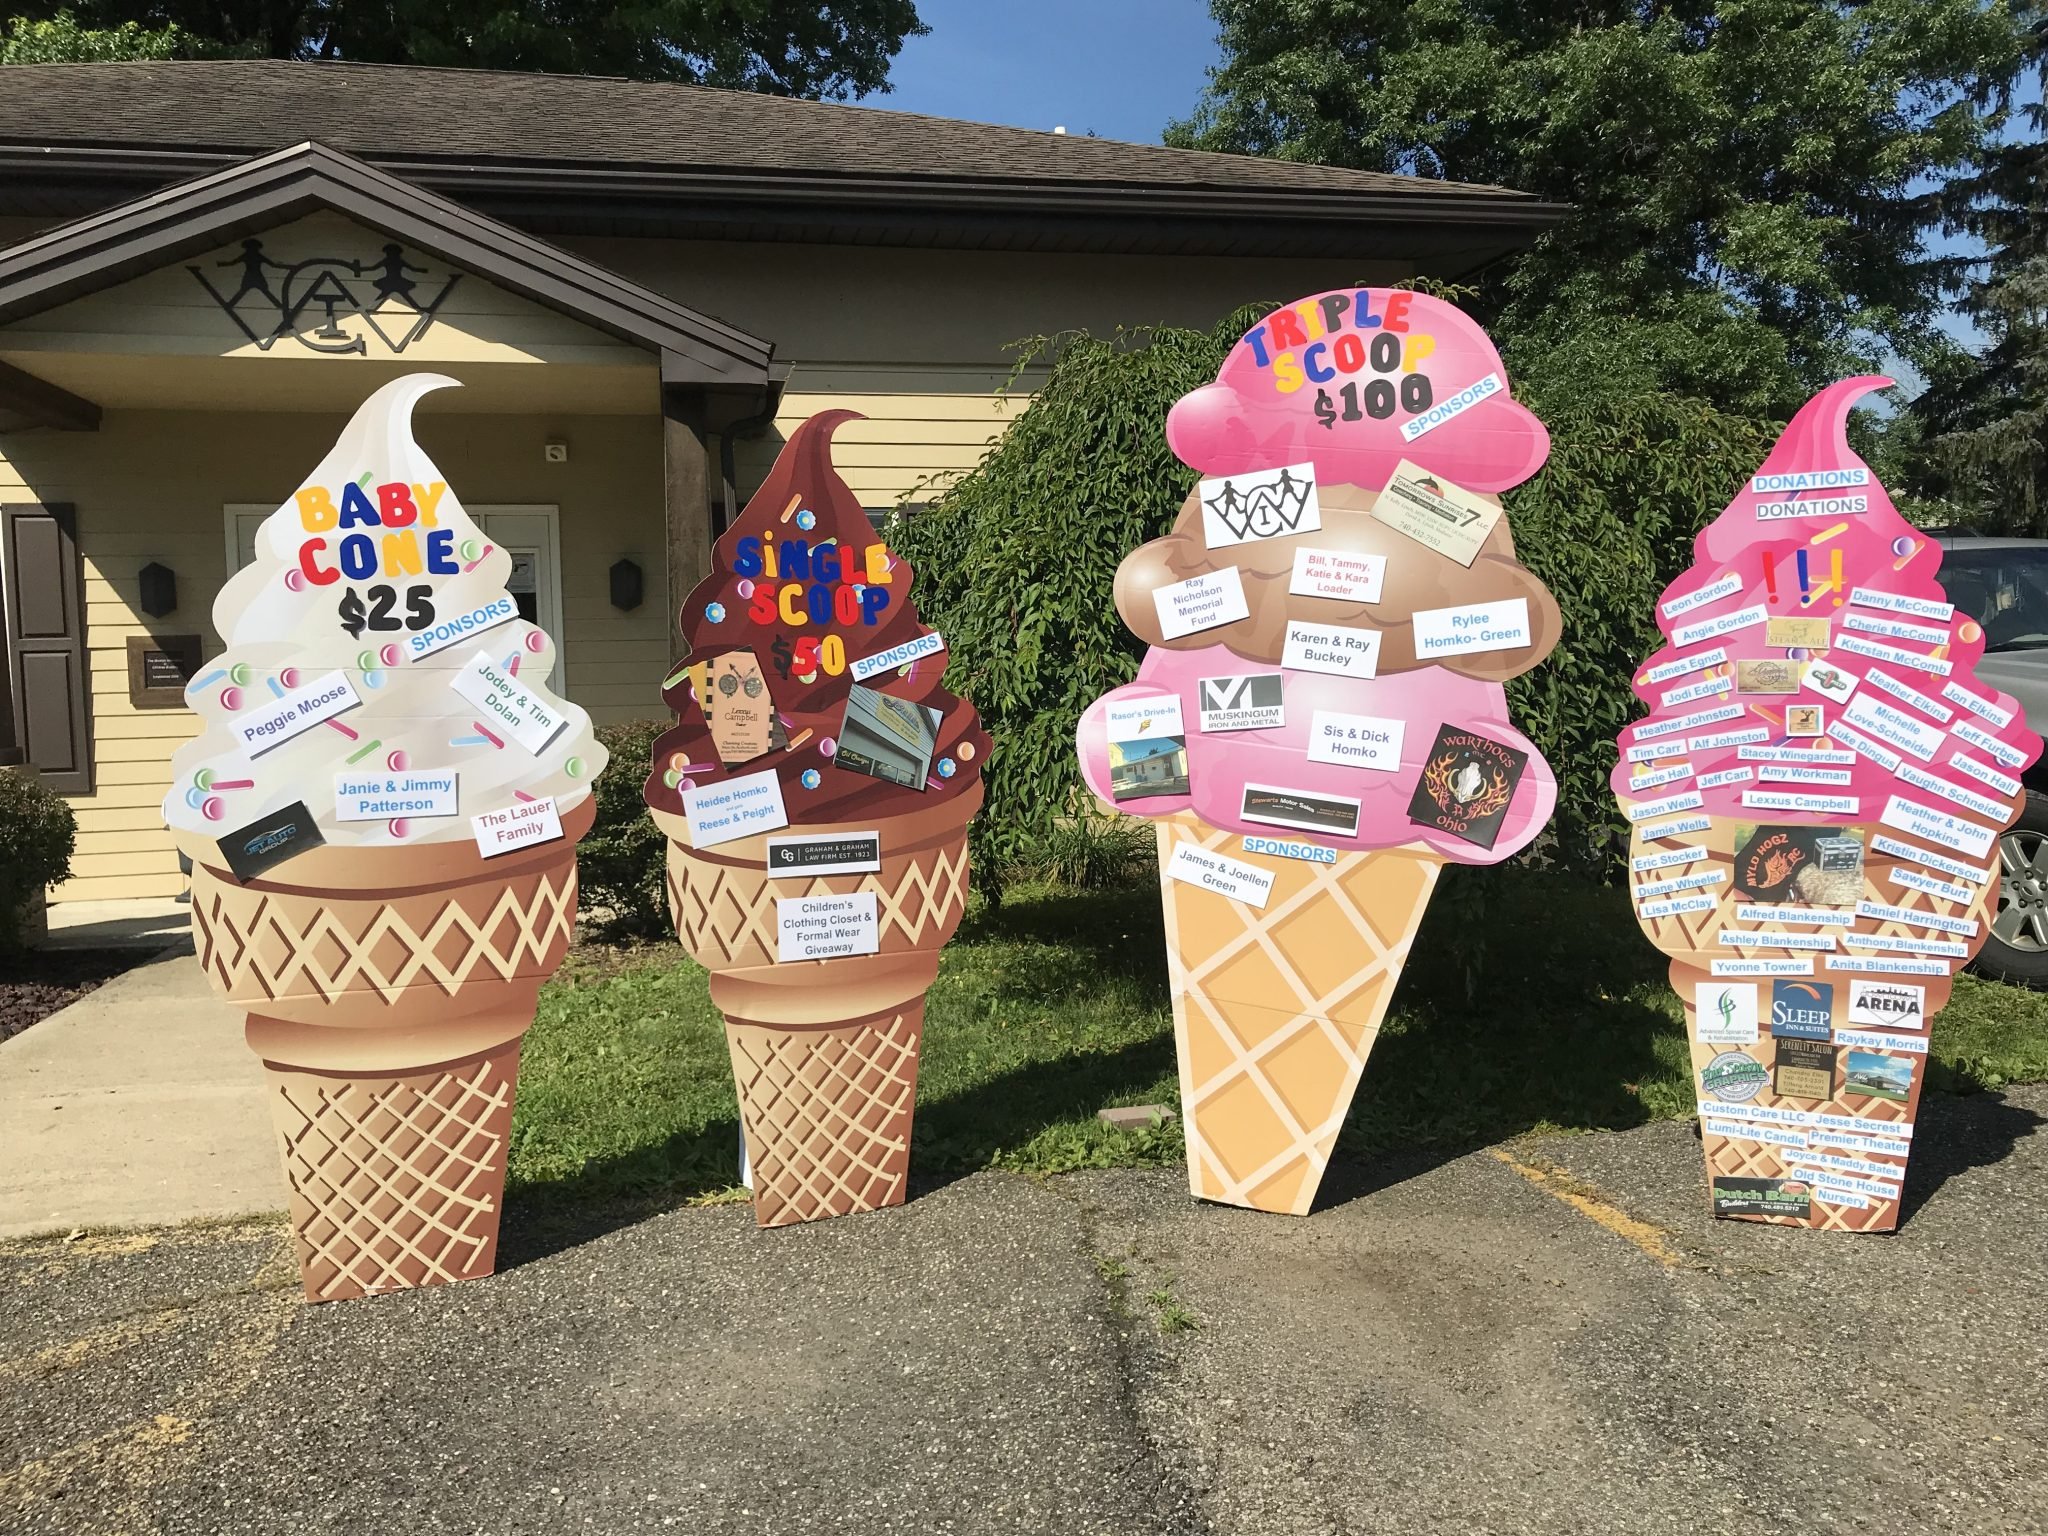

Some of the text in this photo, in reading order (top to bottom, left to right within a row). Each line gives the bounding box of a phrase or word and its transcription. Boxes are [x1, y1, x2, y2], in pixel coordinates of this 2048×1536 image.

[1244, 291, 1413, 367] TRIPLE
[1273, 333, 1436, 394] SCOOP
[1313, 373, 1433, 430] $100
[1407, 377, 1496, 437] SPONSORS
[1756, 470, 1864, 490] DONATIONS
[295, 481, 447, 532] BABY
[1758, 498, 1865, 517] DONATIONS
[299, 529, 459, 585] CONE
[1308, 555, 1370, 573] Bill, Tammy,
[1185, 577, 1205, 590] Ray
[1305, 568, 1369, 584] Katie & Kara
[1173, 585, 1223, 605] Nicholson
[1317, 582, 1353, 596] Loader
[1664, 581, 1735, 615] Leon Gordon
[338, 585, 435, 641] $25
[749, 584, 890, 626] SCOOP
[1178, 598, 1223, 618] Memorial
[1853, 590, 1949, 616] Danny McComb
[411, 598, 512, 652] SPONSORS
[1191, 612, 1217, 626] Fund
[1452, 613, 1490, 628] Rylee
[1683, 611, 1759, 640] Angie Gordon
[1291, 630, 1370, 652] Karen & Ray
[1480, 626, 1521, 642] Green
[771, 634, 845, 679] $50
[857, 635, 938, 675] SPONSORS
[1304, 648, 1351, 667] Buckey
[1651, 651, 1723, 680] James Egnot
[1841, 638, 1890, 658] Kierstan
[1894, 651, 1947, 674] McComb
[478, 665, 551, 728] Jodey & Tim
[1668, 678, 1730, 703] Jodi Edgell
[243, 684, 347, 743] Peggie Moose
[484, 693, 520, 727] Dolan
[725, 713, 757, 721] Campbell
[1112, 707, 1176, 720] Rasor's Drive-In
[1208, 709, 1279, 720] MUSKINGUM
[1945, 689, 2003, 725] Jon Elkins
[1639, 707, 1738, 737] Heather Johnston
[1875, 706, 1921, 735] Michelle
[1324, 725, 1390, 744] Sis & Dick
[1713, 731, 1766, 746] Johnston
[1847, 709, 1934, 758] Love-Schneider
[1332, 742, 1377, 759] Homko
[1957, 727, 2021, 764] Jeff Furbee
[339, 777, 452, 795] Janie & Jimmy
[1902, 768, 2008, 820] Vaughn Schneider
[360, 797, 434, 812] Patterson
[696, 795, 731, 809] Heidee
[733, 786, 768, 800] Homko
[1280, 798, 1298, 806] Motor
[1299, 803, 1314, 813] Sales
[1750, 795, 1850, 812] Lexxus Campbell
[479, 800, 551, 828] The Lauer
[699, 818, 730, 831] Reese
[733, 814, 740, 822] &
[743, 805, 775, 820] Peight
[1895, 801, 1988, 841] Heather & John
[267, 827, 296, 844] AUTO
[496, 821, 544, 843] Family
[1911, 822, 1960, 847] Hopkins
[1244, 838, 1335, 863] SPONSORS
[1757, 834, 1789, 856] HOGZ
[1787, 847, 1801, 862] RC
[1180, 850, 1269, 889] James & Joellen
[1878, 838, 1980, 881] Kristin Dickerson
[1202, 872, 1237, 894] Green
[802, 901, 853, 913] Children's
[784, 913, 871, 928] Clothing Closet &
[797, 928, 860, 941] Formal Wear
[805, 944, 853, 955] Giveaway
[1717, 963, 1807, 971] Yvonne Towner
[1831, 959, 1943, 975] Anita Blankenship
[1773, 1000, 1829, 1025] SLEEP
[1856, 996, 1920, 1014] ARENA
[1703, 1102, 1805, 1122] Custom Care LLC
[1707, 1121, 1805, 1146] Lumi-Lite Candle
[1794, 1169, 1895, 1196] Old Stone House
[1714, 1188, 1762, 1200] Dutch
[1818, 1189, 1865, 1208] Nursery
